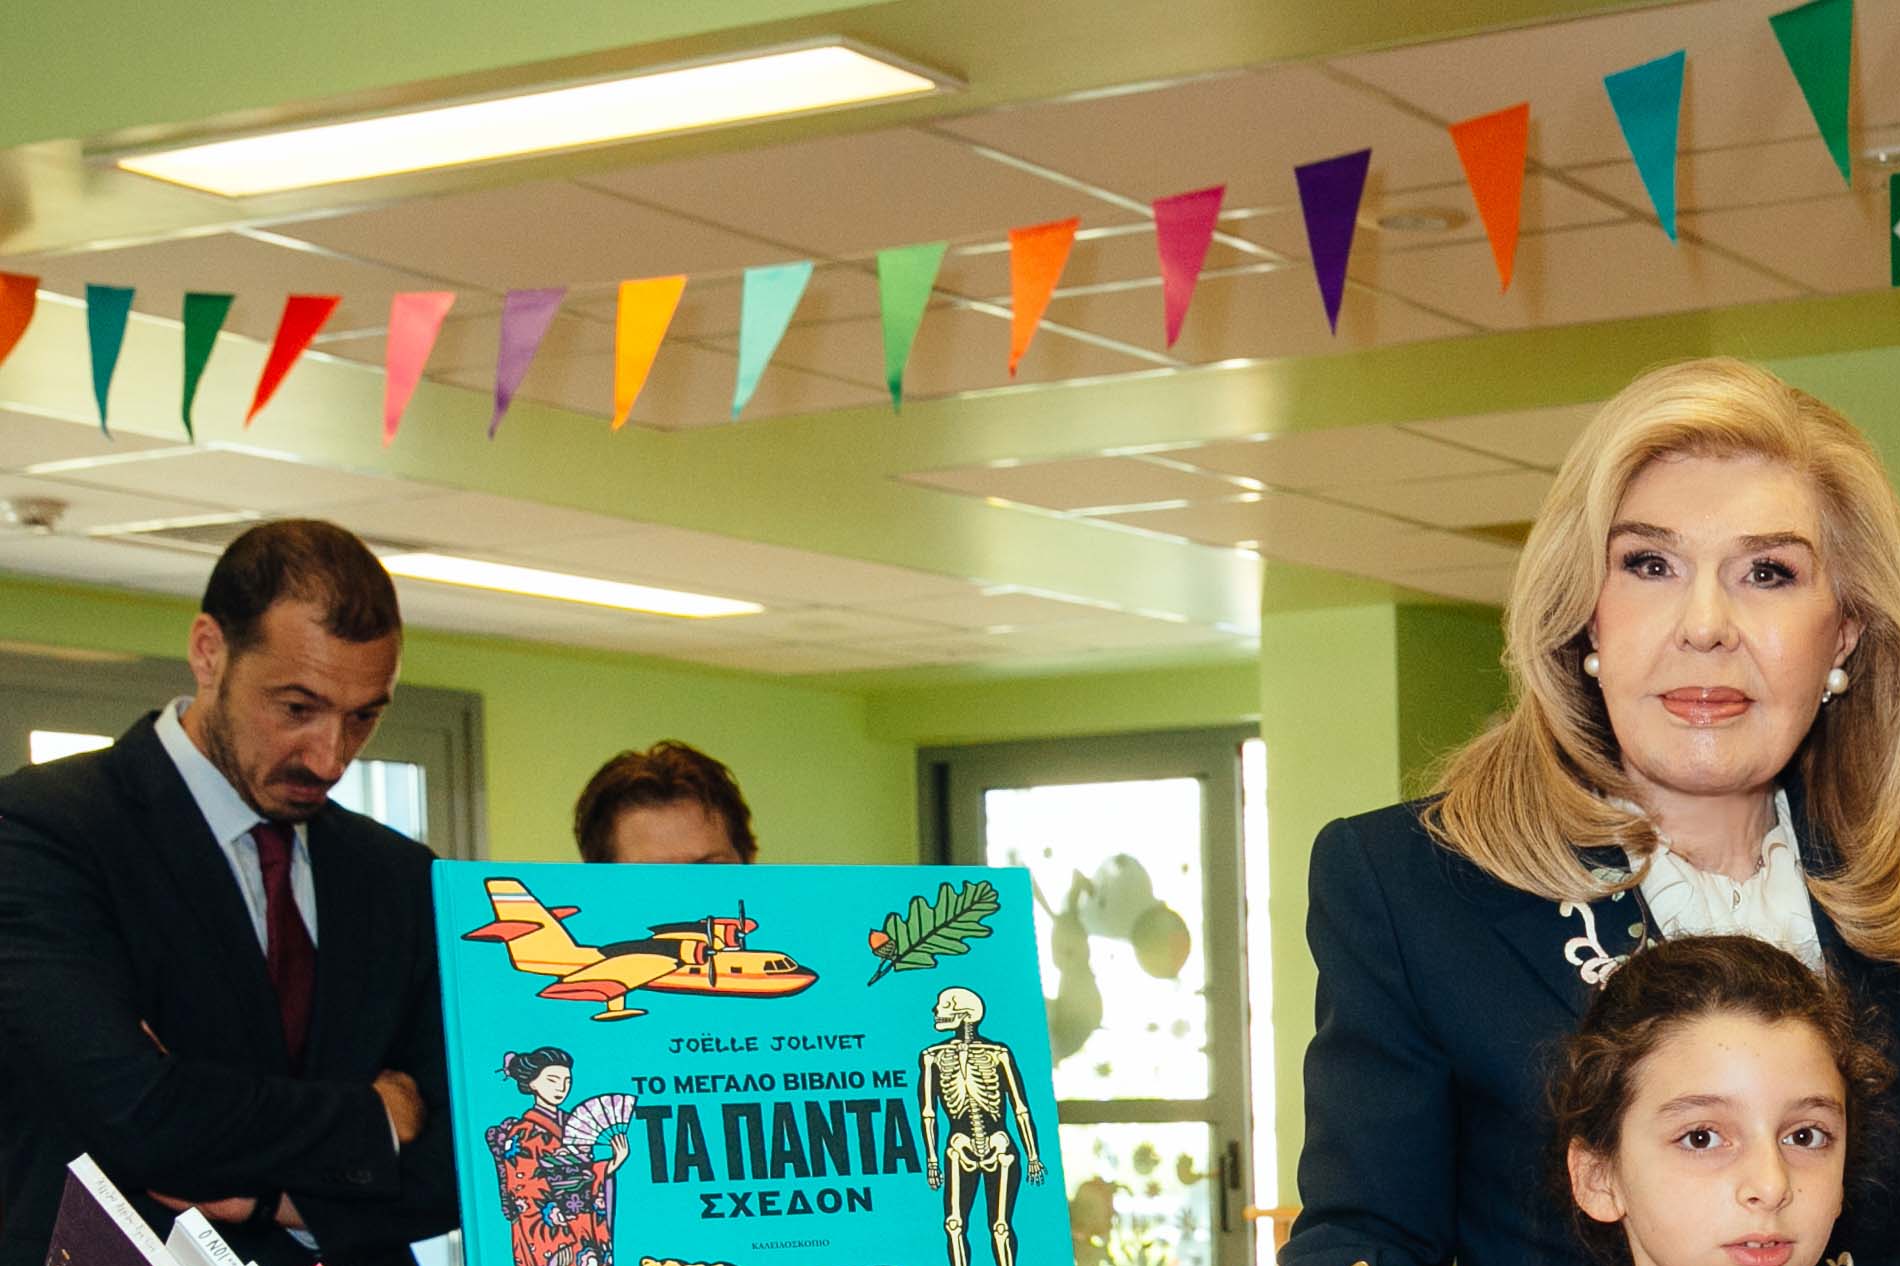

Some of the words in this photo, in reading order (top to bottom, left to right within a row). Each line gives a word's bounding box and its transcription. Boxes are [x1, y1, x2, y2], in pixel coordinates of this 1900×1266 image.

[669, 1033, 758, 1053] JOËLLE
[770, 1034, 865, 1051] JOLIVET
[632, 1076, 666, 1094] ΤΟ
[674, 1073, 775, 1094] ΜΕΓΑΛΟ
[783, 1071, 865, 1091] ΒΙΒΛΙΟ
[873, 1070, 907, 1088] ΜΕ
[635, 1104, 715, 1184] ΤΑ
[722, 1098, 922, 1180] ΠΑΝΤΑ
[700, 1186, 873, 1219] ΣΧΕΔΟΝ
